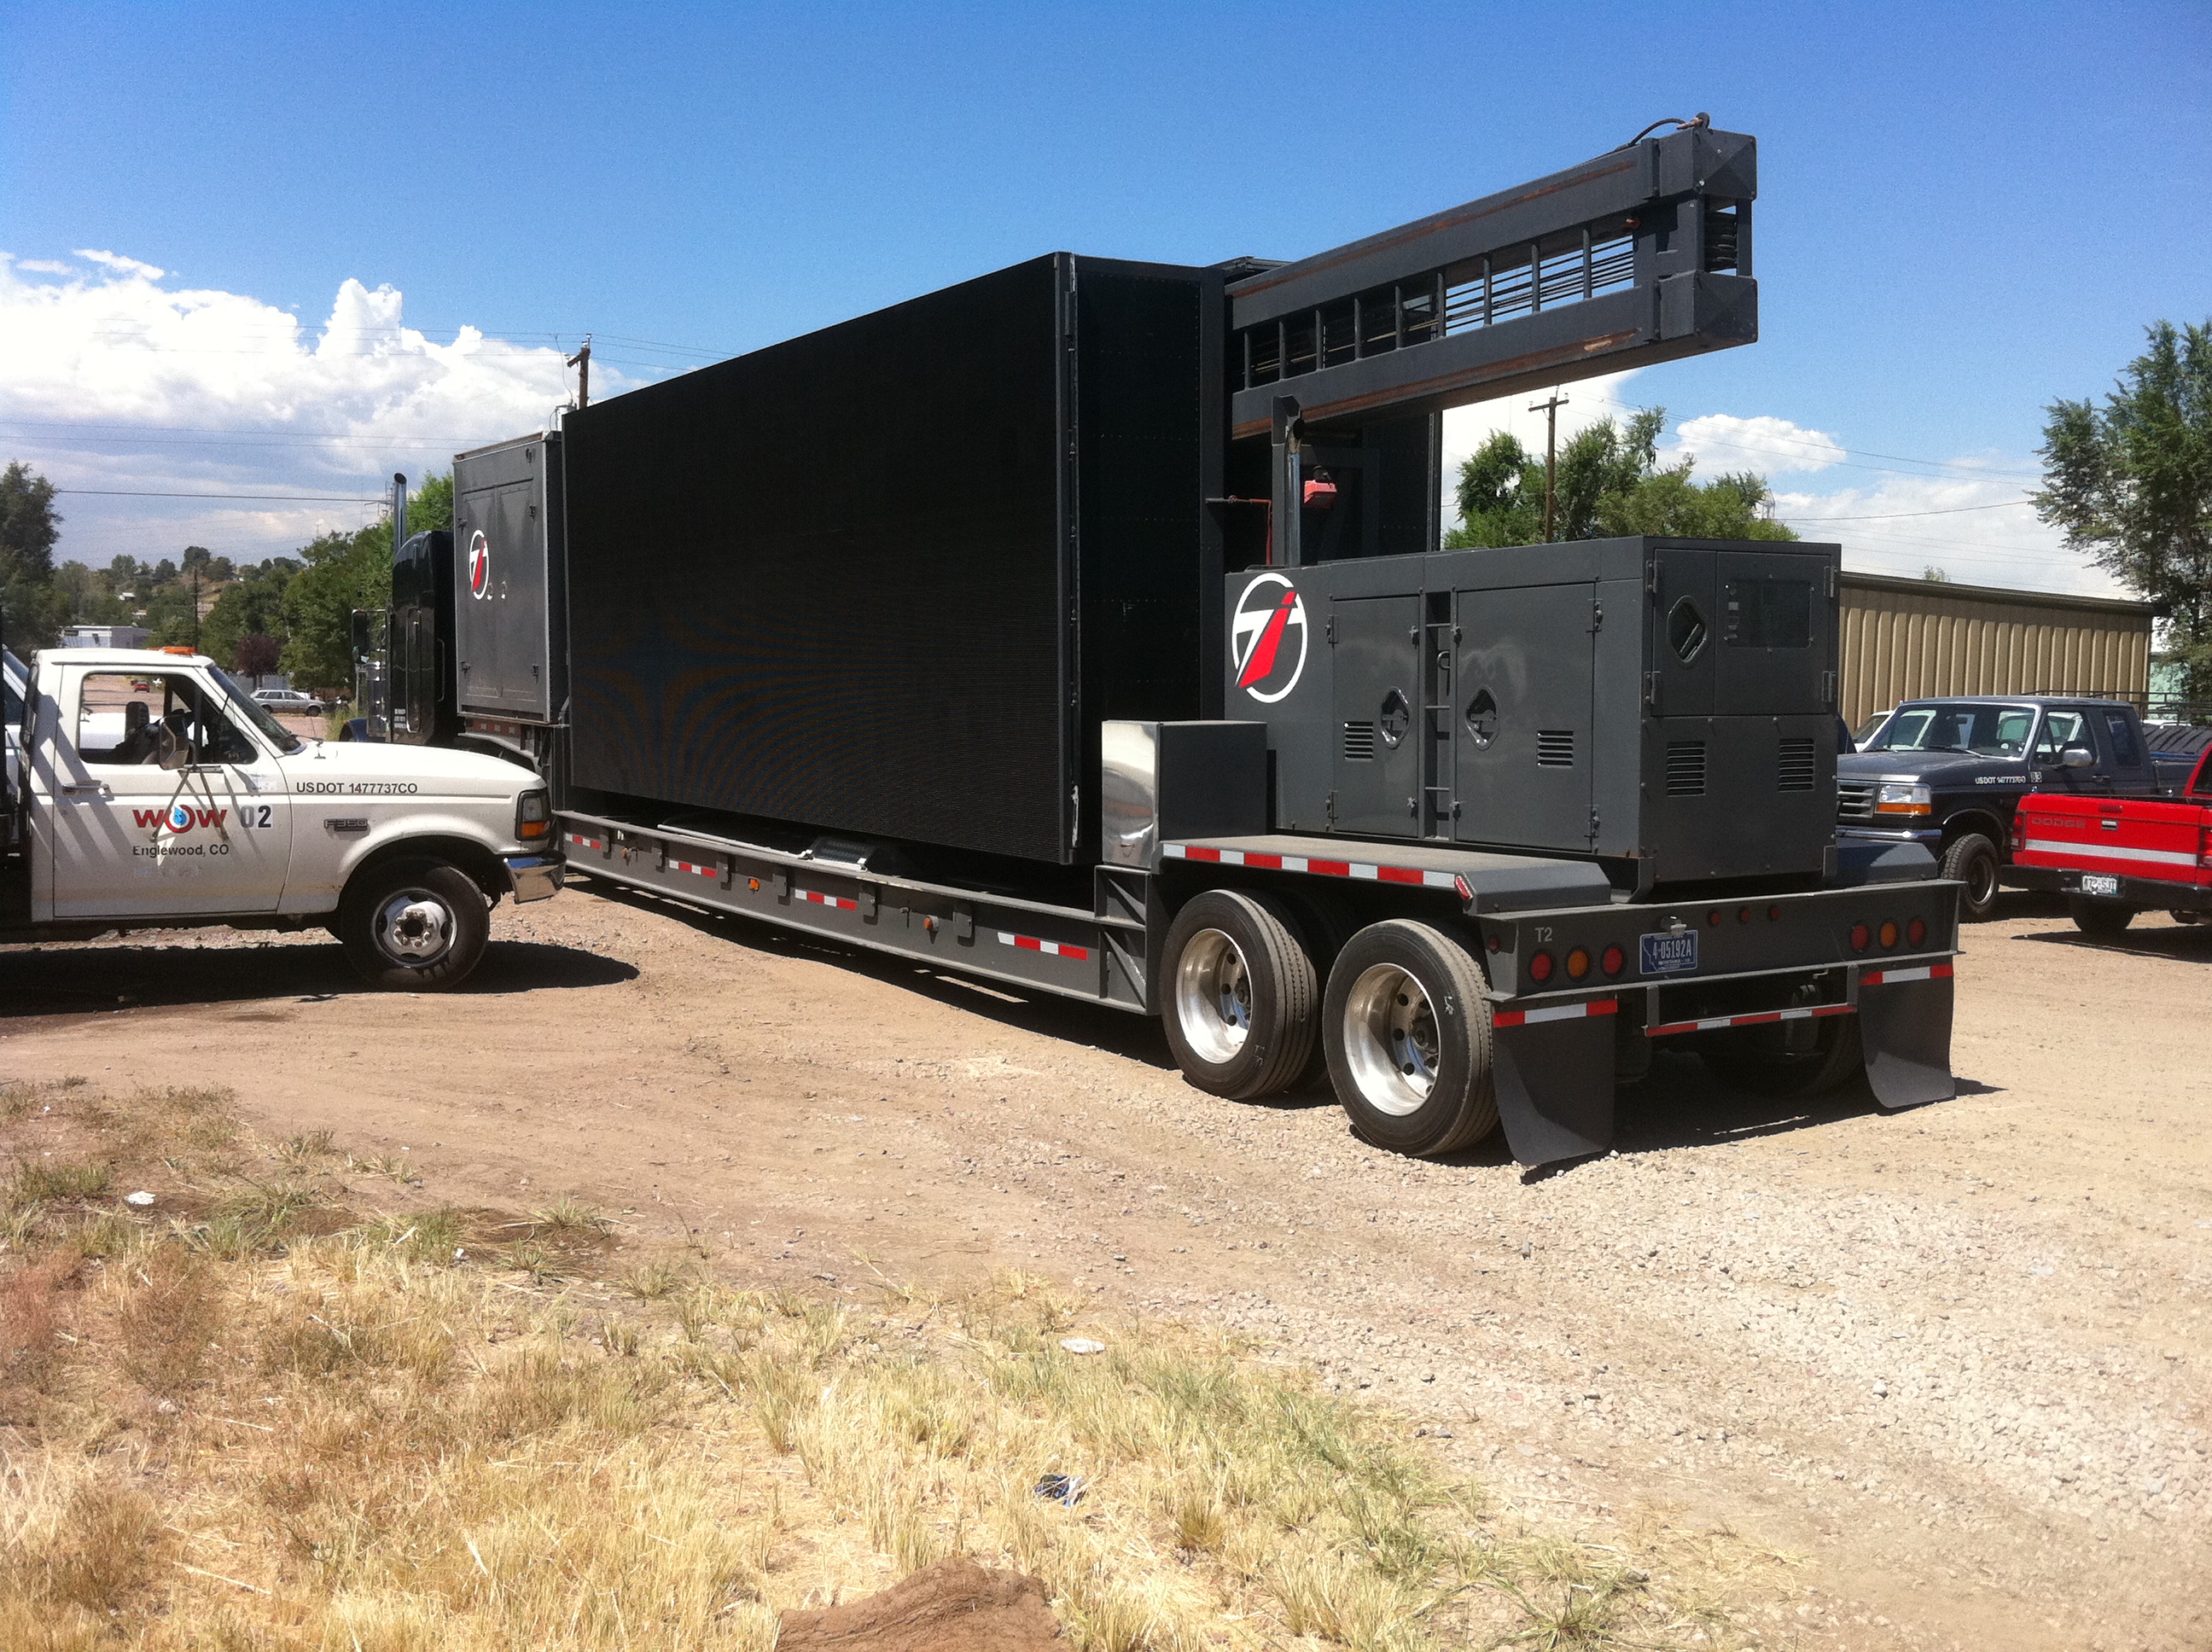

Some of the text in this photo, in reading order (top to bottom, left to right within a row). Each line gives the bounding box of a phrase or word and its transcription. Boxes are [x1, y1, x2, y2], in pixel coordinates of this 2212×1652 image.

[349, 782, 418, 794] 1477737CO
[241, 805, 272, 829] 02
[2032, 817, 2086, 829] DODGE
[133, 844, 230, 858] Englewood, CO
[1534, 927, 1553, 943] T2
